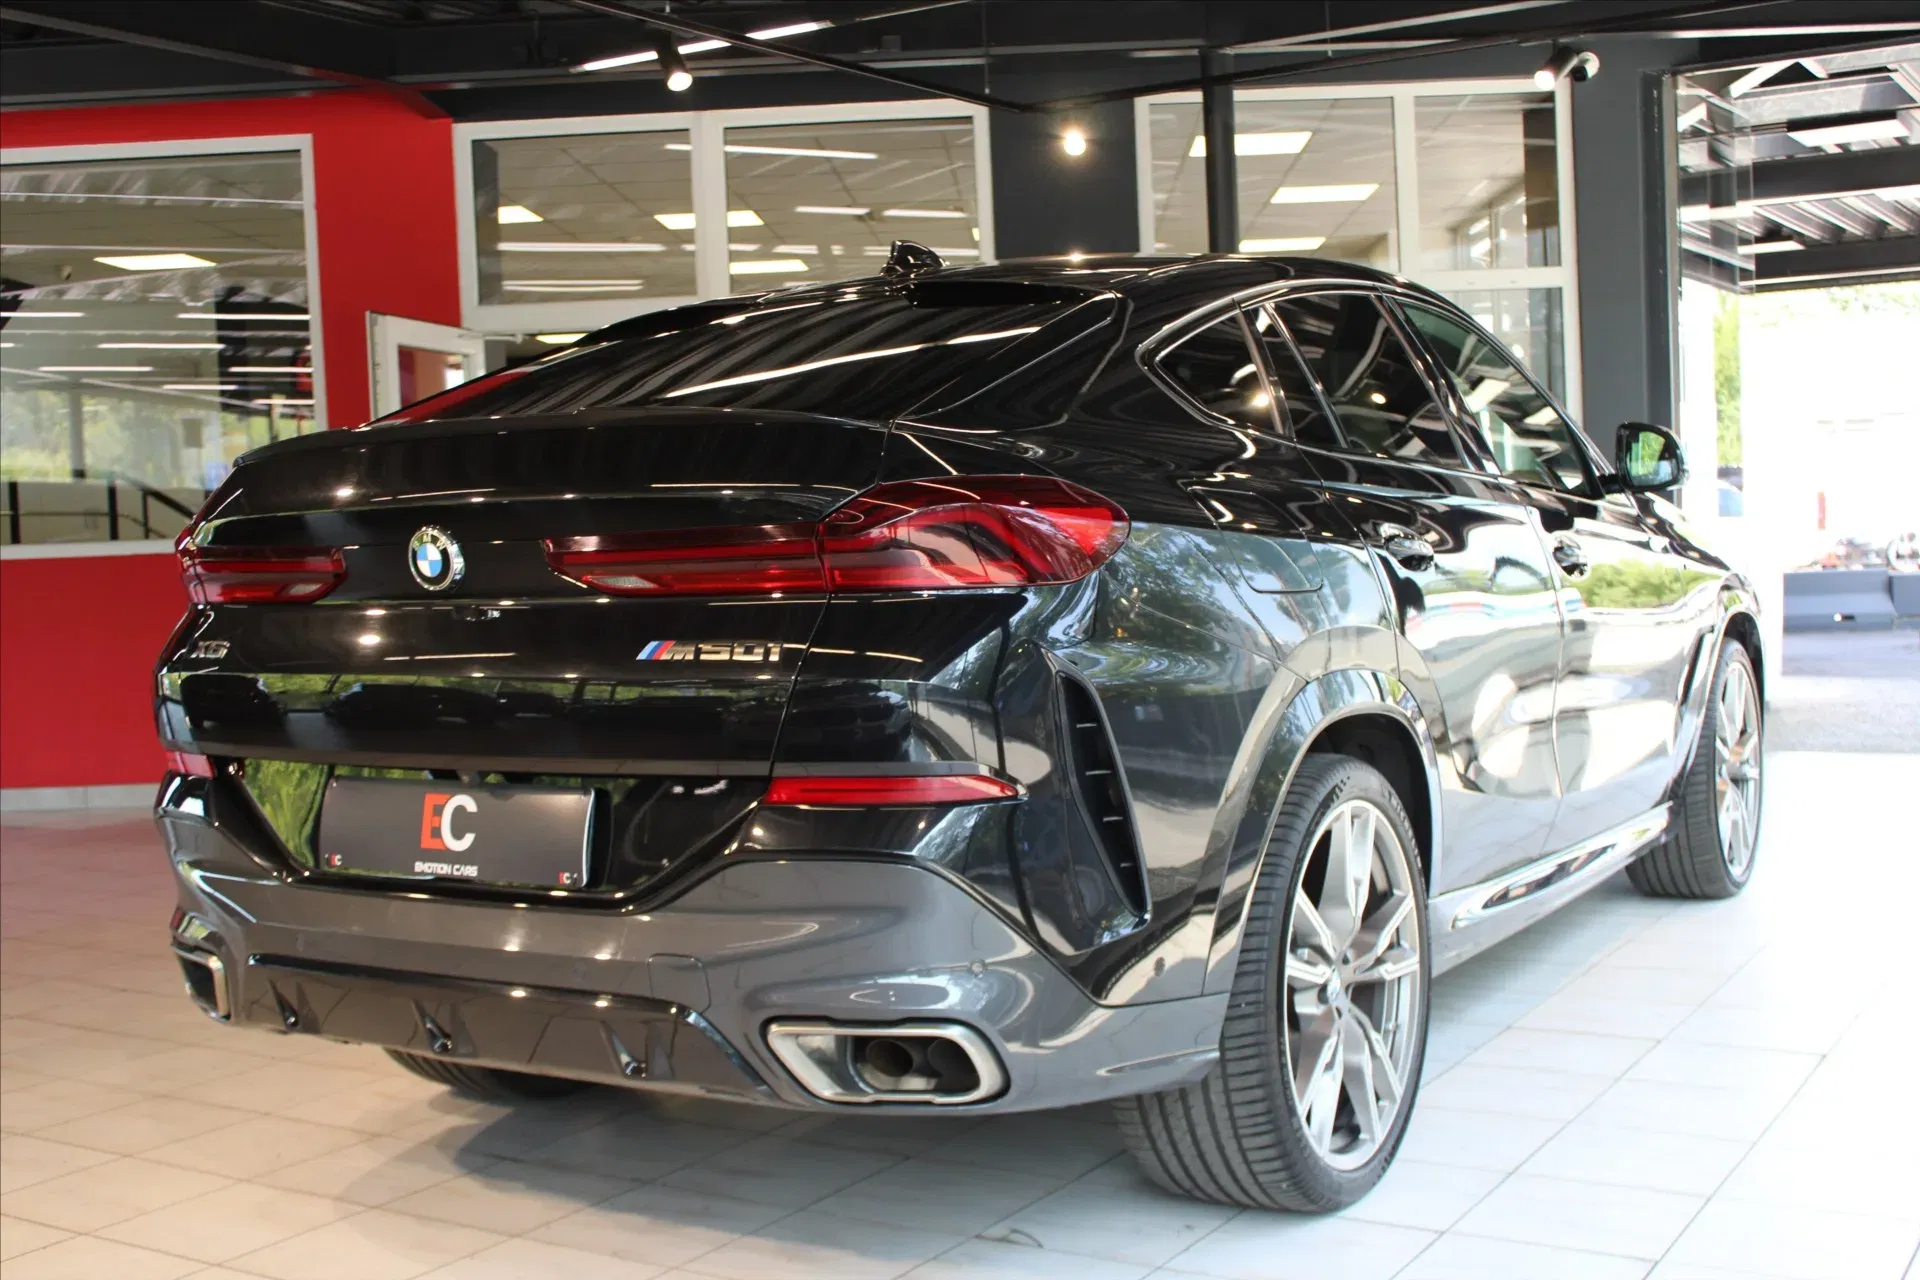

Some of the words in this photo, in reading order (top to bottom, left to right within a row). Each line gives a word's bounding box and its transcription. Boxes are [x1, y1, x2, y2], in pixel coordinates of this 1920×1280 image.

[412, 532, 447, 551] BMW
[420, 793, 478, 852] EC
[414, 861, 452, 875] EMOTION
[453, 864, 479, 877] CARS
